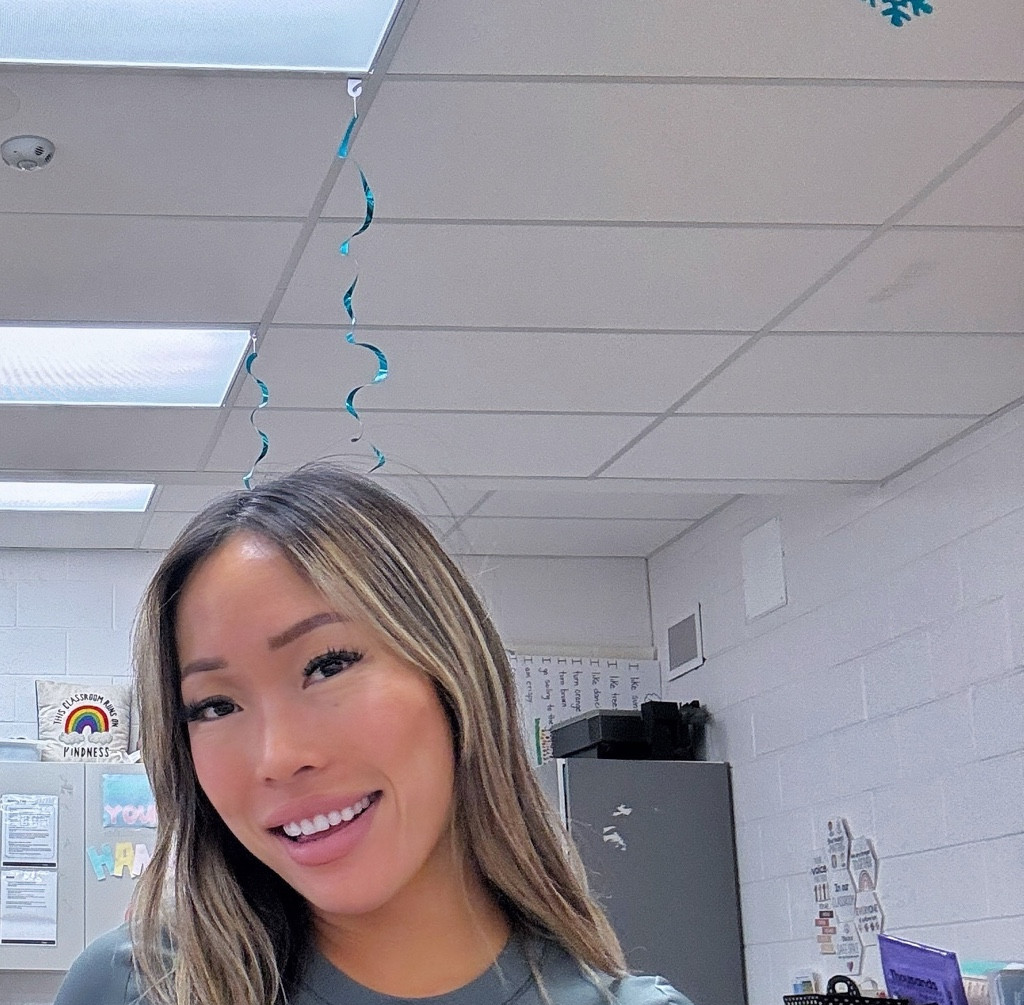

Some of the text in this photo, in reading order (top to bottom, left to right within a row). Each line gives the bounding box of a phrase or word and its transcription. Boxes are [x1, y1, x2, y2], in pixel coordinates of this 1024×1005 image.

[524, 656, 533, 664] I
[590, 659, 600, 668] I
[607, 660, 618, 670] I
[628, 662, 639, 671] I
[591, 672, 601, 685] like
[609, 675, 620, 689] like
[630, 677, 640, 690] like
[53, 693, 119, 728] THIS CLASSROOM RUNS ON
